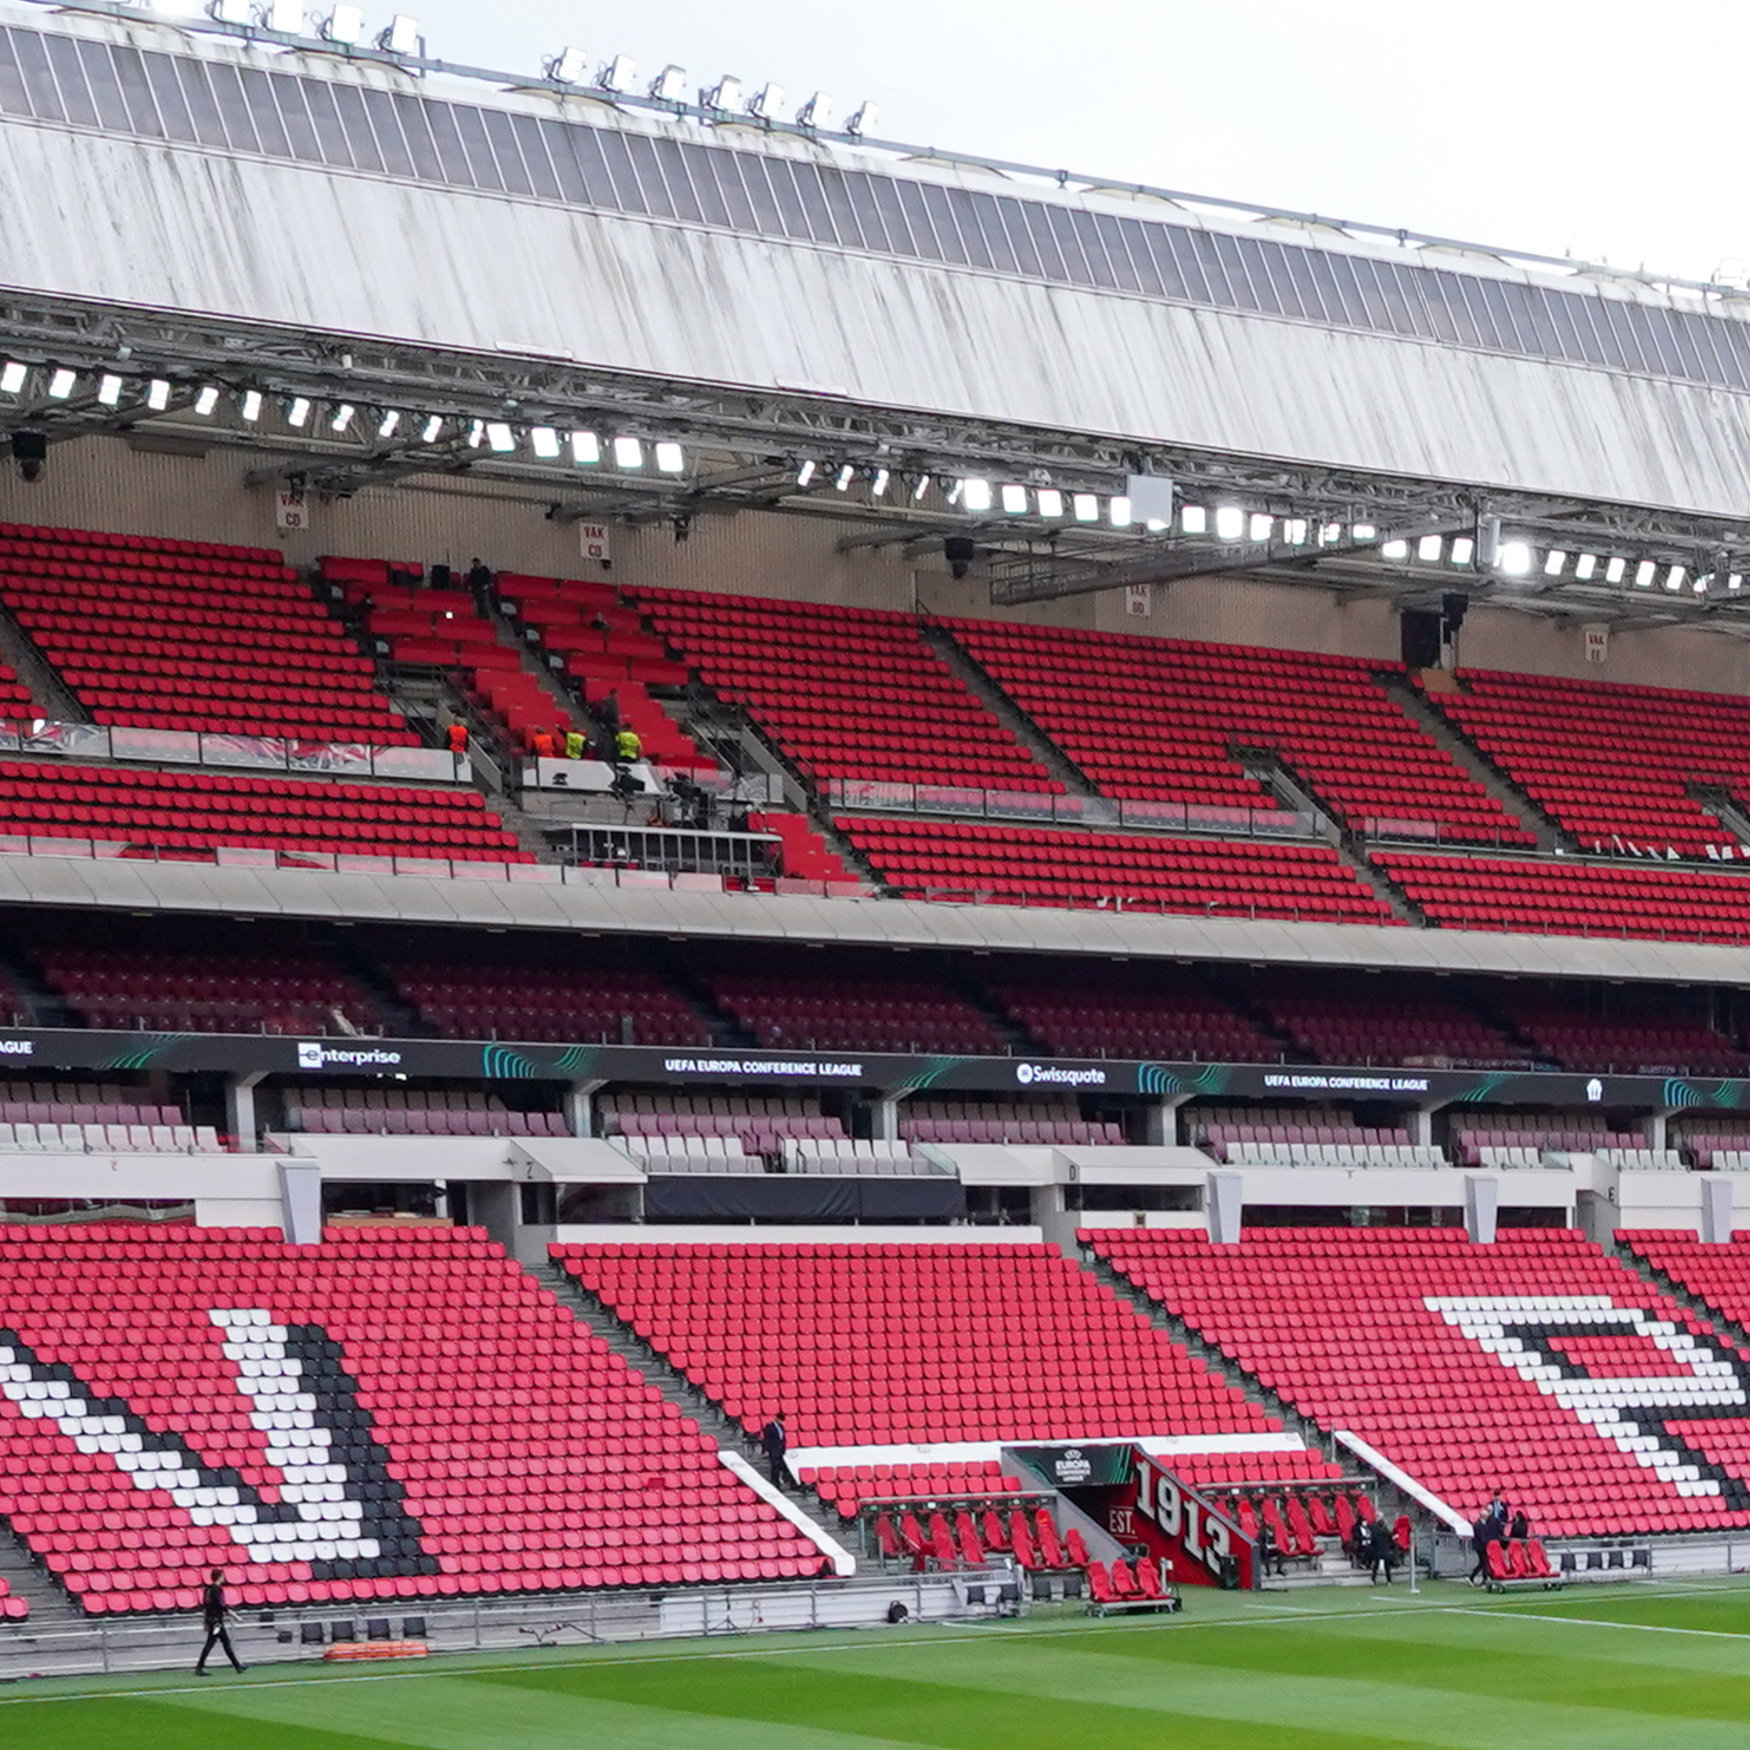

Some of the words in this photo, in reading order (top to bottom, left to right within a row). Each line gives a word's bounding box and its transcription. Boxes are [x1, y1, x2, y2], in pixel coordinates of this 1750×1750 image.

[299, 1042, 402, 1068] enterprise
[664, 1059, 697, 1072] UEFA
[697, 1059, 742, 1073] EUROPA
[742, 1060, 817, 1075] CONFERENCE
[818, 1063, 862, 1077] LEAGUE
[1032, 1065, 1106, 1086] Swissquote
[1264, 1074, 1291, 1087] UEFA
[1291, 1075, 1329, 1088] EUROPA
[1328, 1076, 1391, 1090] CONFERENCE
[1391, 1078, 1428, 1091] LEAGUE
[1109, 1510, 1136, 1535] EST.
[1136, 1460, 1230, 1575] 1913
